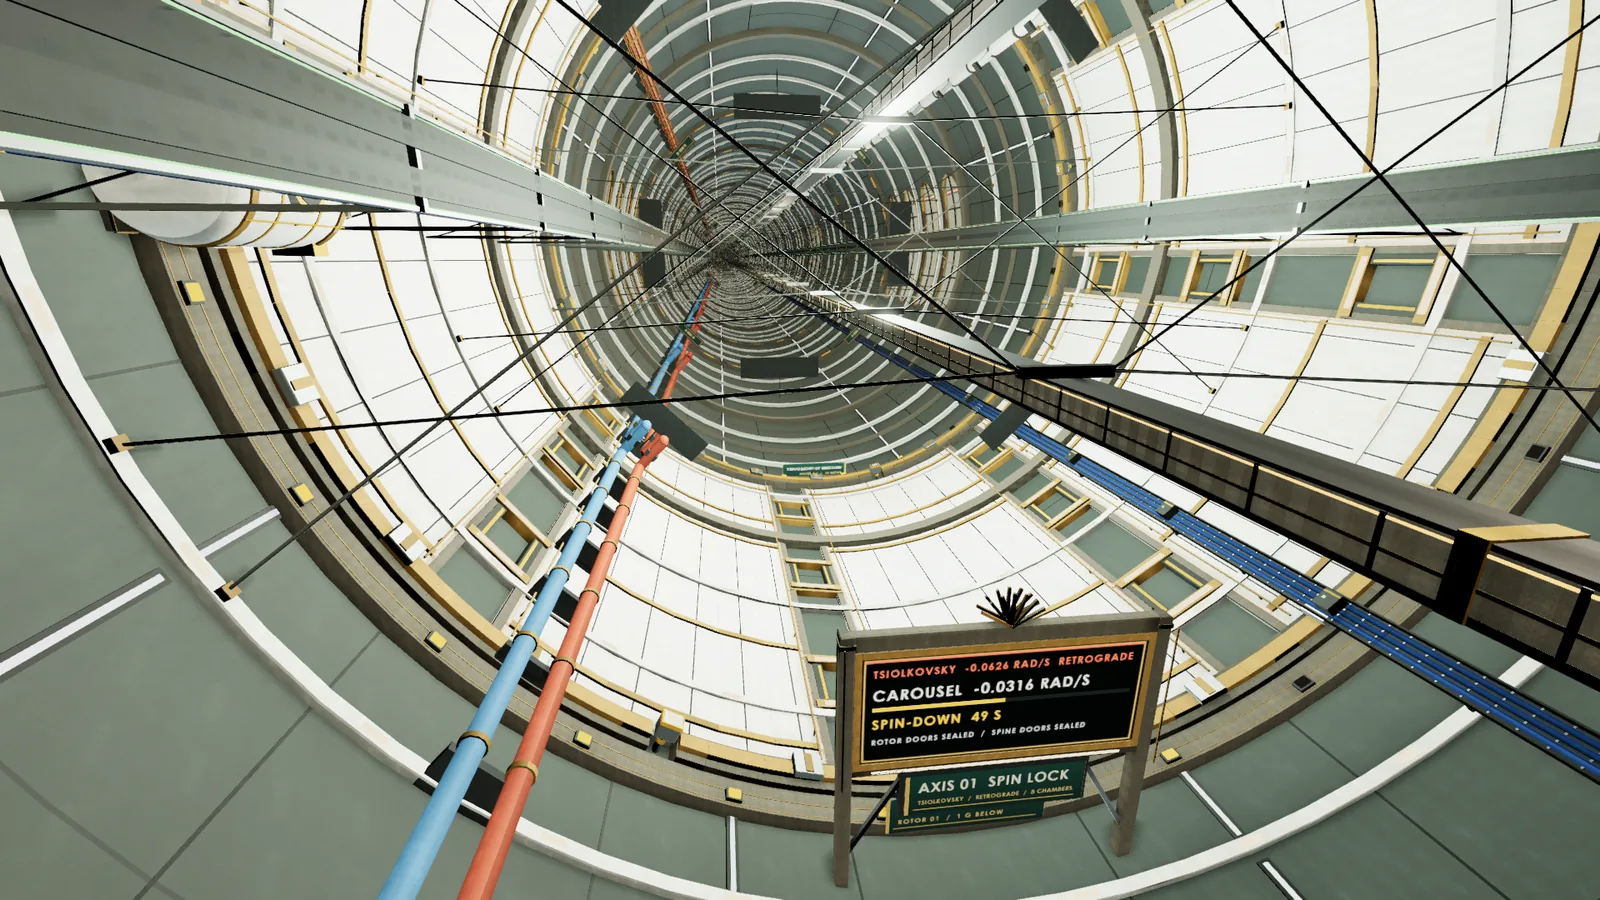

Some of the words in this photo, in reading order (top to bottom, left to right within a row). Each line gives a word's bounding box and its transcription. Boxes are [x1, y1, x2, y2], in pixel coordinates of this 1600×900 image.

[873, 665, 956, 680] TSIOLKOVSKY
[965, 661, 1009, 672] -0.0626
[1013, 658, 1050, 669] RAD/S
[1058, 652, 1134, 666] RETROGRADE
[873, 685, 962, 702] CAROUSEL
[974, 678, 1034, 694] -0.0316
[1040, 674, 1090, 689] RAD/S
[872, 713, 961, 731] SPIN-DOWN
[971, 711, 988, 722] 49
[994, 710, 1001, 720] S
[871, 737, 902, 746] ROTOR
[905, 734, 938, 744] DOORS
[942, 731, 974, 740] SEALED
[992, 727, 1016, 736] SPINE
[1019, 724, 1051, 733] DOORS
[1054, 721, 1086, 730] SEALED
[918, 780, 954, 794] AXIS
[960, 778, 976, 790] 01
[988, 774, 1022, 787] SPIN
[1027, 769, 1069, 783] LOCK
[918, 796, 964, 805] TSIOLKOVSKY
[976, 790, 1019, 800] RETROGRADE
[1036, 786, 1073, 794] CHAMBERS
[898, 817, 926, 825] ROTOR
[929, 815, 940, 823] 01
[975, 809, 1003, 817] BELOW
